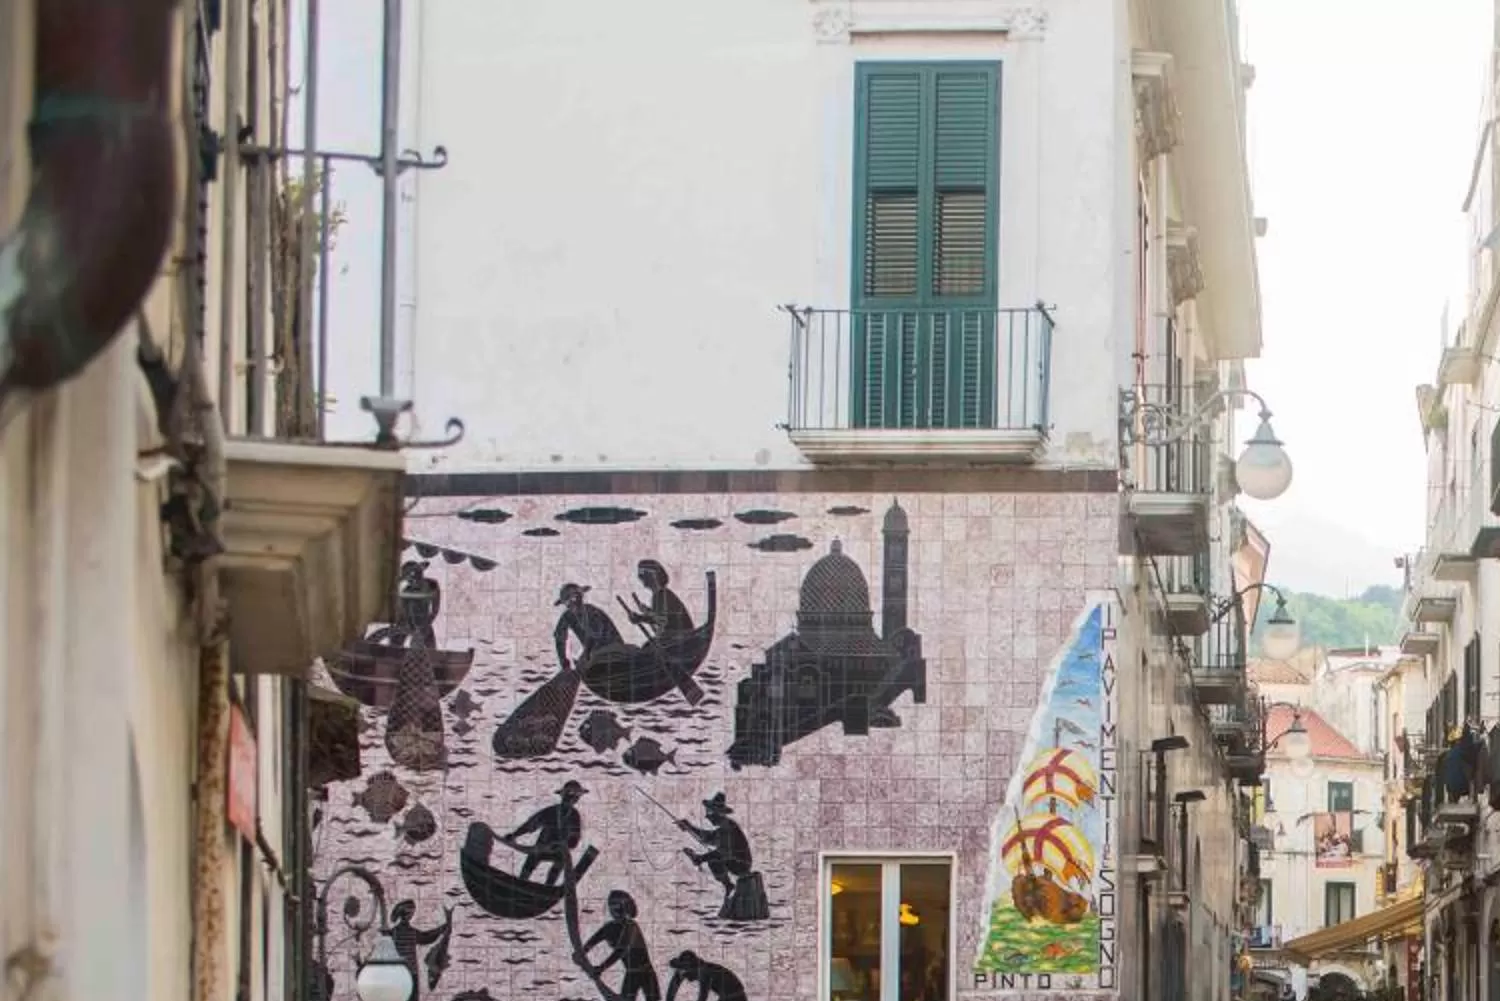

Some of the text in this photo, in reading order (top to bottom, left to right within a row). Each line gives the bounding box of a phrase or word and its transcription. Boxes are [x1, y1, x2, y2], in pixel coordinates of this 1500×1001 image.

[1101, 628, 1117, 842] PAVIMENTI
[974, 973, 1051, 990] PINTO
[1100, 870, 1115, 989] SOGNO
